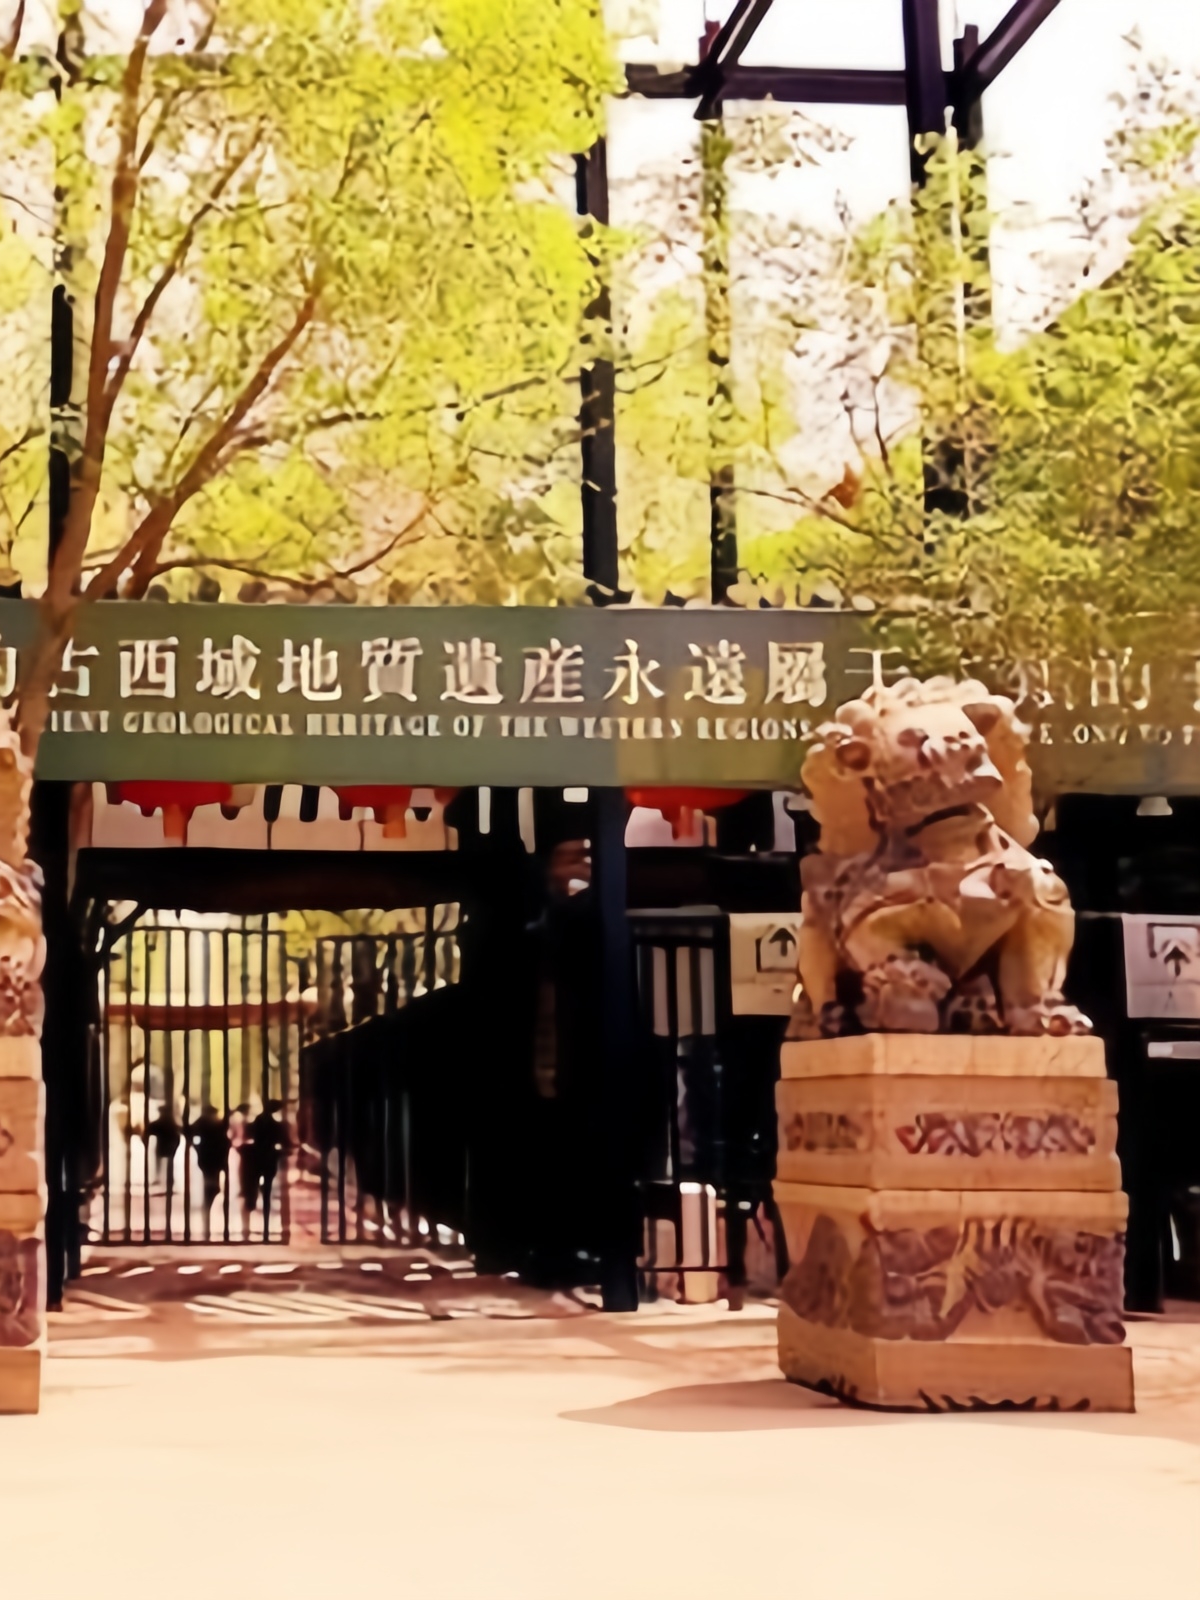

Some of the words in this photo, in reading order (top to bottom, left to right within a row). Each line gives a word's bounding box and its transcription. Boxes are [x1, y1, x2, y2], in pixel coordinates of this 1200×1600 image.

[122, 711, 294, 735] GEOLOGICAL
[306, 713, 441, 736] HERITAGE
[452, 714, 484, 737] OF
[499, 715, 548, 738] THE
